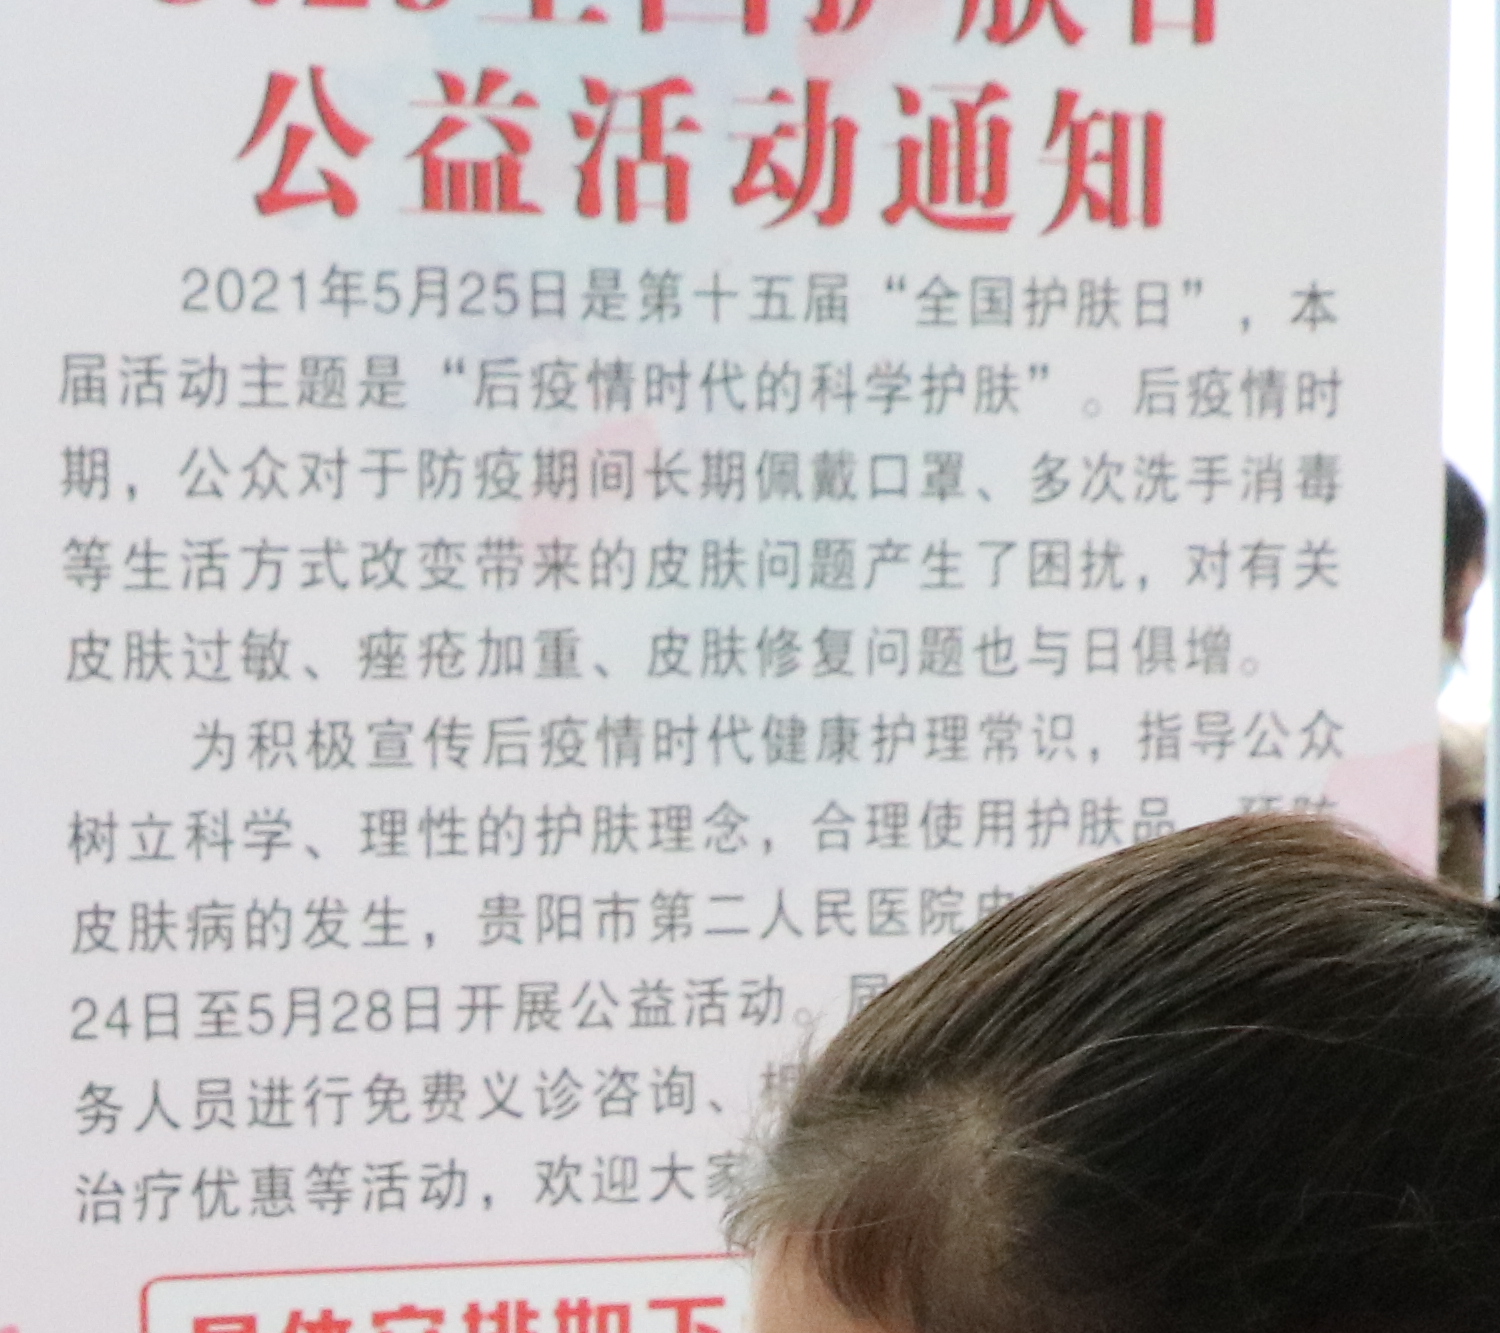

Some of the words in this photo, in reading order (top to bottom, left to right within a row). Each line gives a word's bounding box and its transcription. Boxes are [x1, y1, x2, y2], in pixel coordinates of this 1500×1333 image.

[235, 65, 1166, 236] 公益活动通知
[71, 887, 1035, 955] 皮肤病的发生，贵阳市第二人民医院
